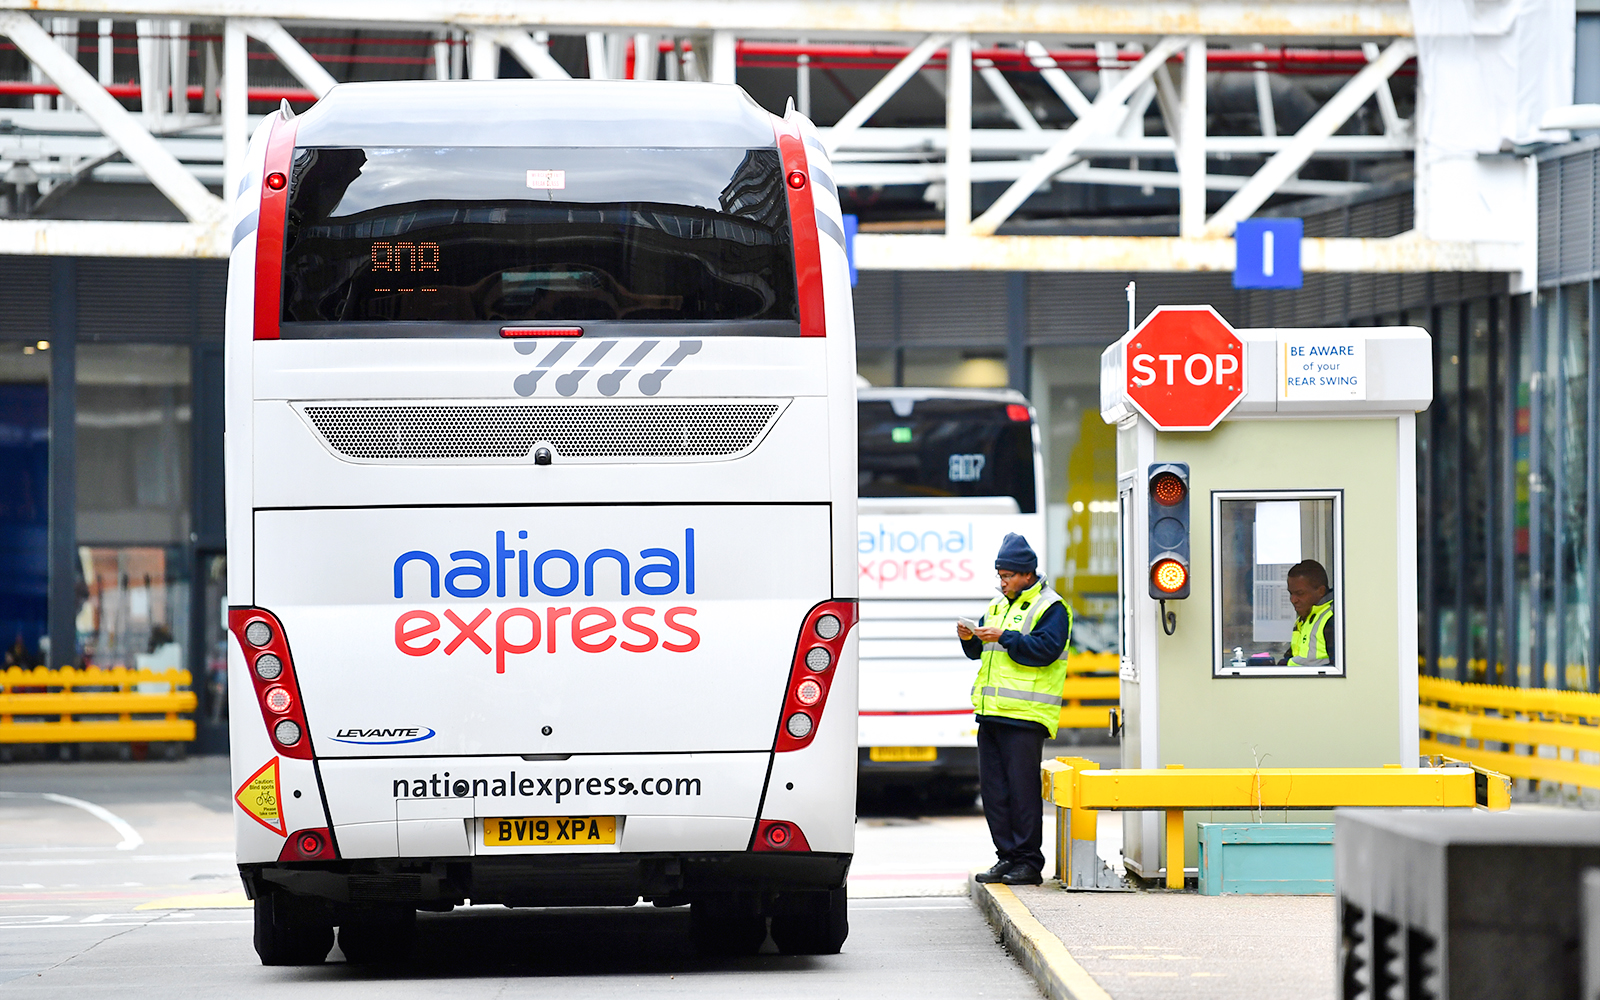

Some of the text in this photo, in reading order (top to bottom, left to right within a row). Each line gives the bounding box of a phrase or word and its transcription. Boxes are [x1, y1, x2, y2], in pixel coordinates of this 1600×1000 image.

[1290, 345, 1354, 356] BE AWARE
[1302, 361, 1340, 372] of your
[1131, 353, 1239, 386] STOP
[1287, 376, 1358, 386] REAR SWING
[858, 522, 973, 554] ational
[393, 527, 695, 599] national
[858, 559, 975, 591] xpress
[394, 606, 701, 674] express
[336, 728, 420, 738] LEVANTE
[392, 771, 702, 804] nationalexpress.com
[498, 819, 600, 841] BV19 XPA
